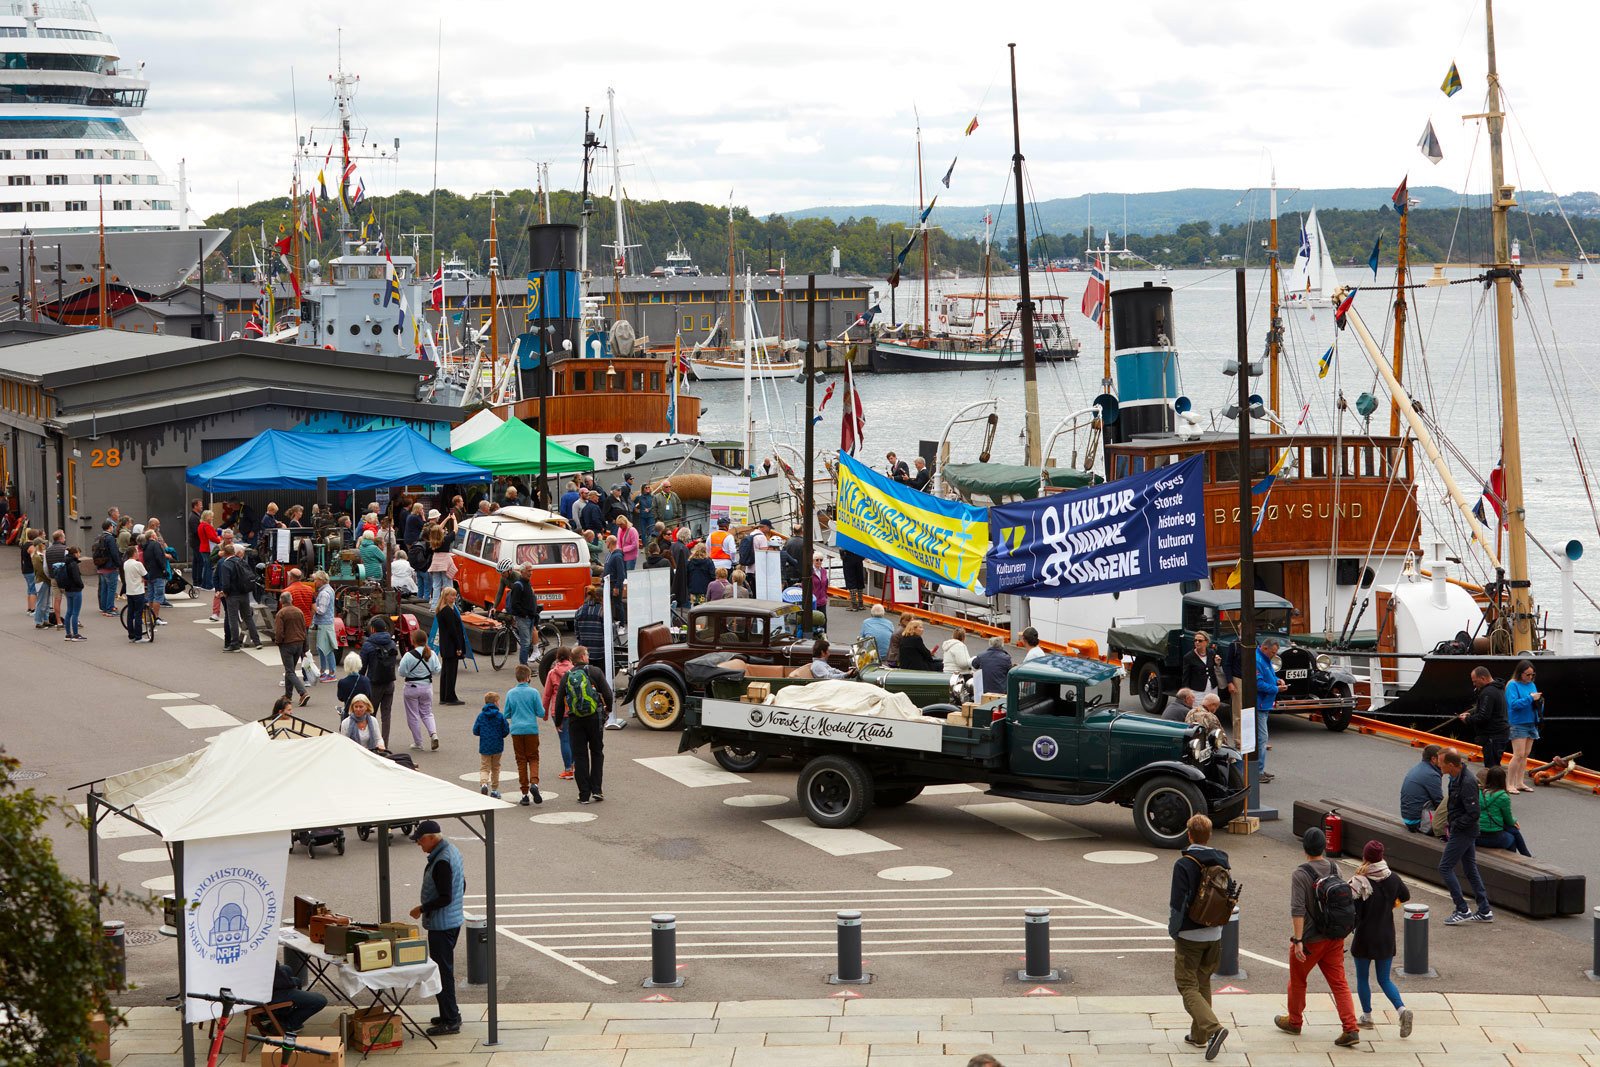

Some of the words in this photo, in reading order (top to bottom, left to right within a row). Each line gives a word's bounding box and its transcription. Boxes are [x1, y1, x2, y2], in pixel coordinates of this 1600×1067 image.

[91, 448, 121, 467] 28
[1154, 474, 1184, 492] Nrges
[1070, 489, 1137, 527] KULTUR
[1154, 493, 1183, 510] største
[838, 509, 851, 525] OSLO
[851, 516, 895, 544] MARITIME
[1158, 512, 1185, 529] historie
[1185, 512, 1196, 527] og
[1068, 521, 1127, 556] MINNE
[1158, 533, 1194, 550] kulturarv
[996, 562, 1027, 575] Kulturvern
[1071, 549, 1141, 584] DAGENE
[1159, 551, 1188, 570] festival
[1286, 670, 1307, 679] E-5414
[765, 710, 800, 732] Norsk
[811, 716, 855, 736] Modell
[848, 722, 893, 741] Klubb
[188, 867, 270, 916] ADIOHISTORISK
[249, 890, 277, 951] FORENING
[188, 921, 208, 959] NORSK
[216, 946, 240, 960] NRHF
